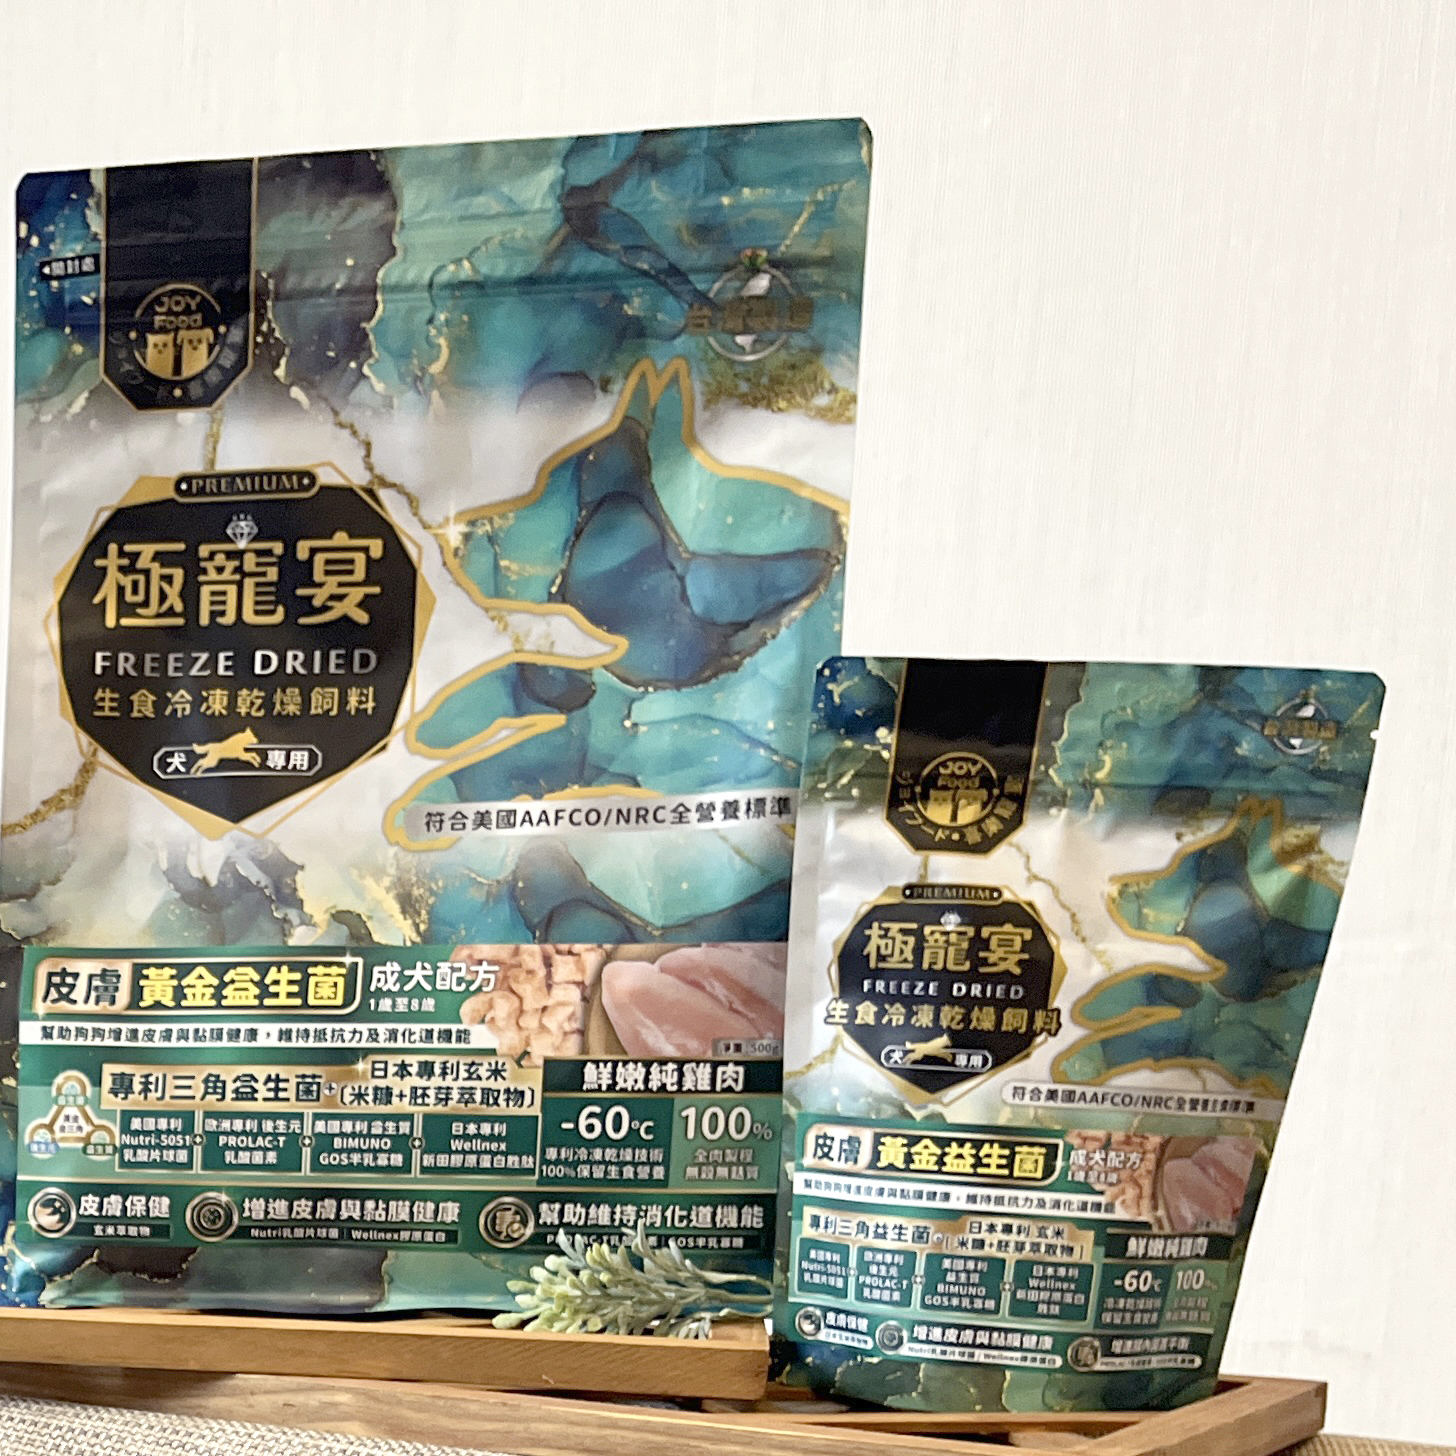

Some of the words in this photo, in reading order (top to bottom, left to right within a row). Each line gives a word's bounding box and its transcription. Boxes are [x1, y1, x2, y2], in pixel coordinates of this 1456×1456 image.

[155, 295, 201, 313] JOY
[154, 313, 202, 329] Food
[191, 474, 300, 495] PREMIUM
[92, 530, 384, 629] 極寵宴
[94, 651, 235, 677] FREEZE
[254, 649, 377, 676] DRIED
[93, 686, 376, 718] 生食冷凍乾燥飼料
[166, 752, 188, 773] 犬
[266, 749, 309, 770] 專用
[939, 762, 982, 776] JOY
[913, 886, 992, 900] PREMIUM
[863, 921, 1033, 976] 極寵宴
[42, 967, 121, 1006] 皮膚
[139, 965, 346, 1007] 黃金益生菌
[369, 961, 501, 992] 成犬配方
[863, 979, 939, 997] FREEZE
[953, 982, 1024, 999] DRIED
[826, 999, 1061, 1035] 生食冷凍乾燥飼料
[371, 1060, 507, 1081] 日本專利玄米
[582, 1061, 744, 1092] 鮮嫩純雞肉
[108, 1072, 322, 1102] 專利三角益生菌
[680, 1106, 773, 1141] 100%
[218, 1136, 286, 1148] PROLAC-T
[333, 1137, 391, 1150] BIMUNO
[451, 1139, 507, 1151] Wellnex
[813, 1132, 861, 1165] 皮膚
[876, 1136, 1046, 1179] 黃金益生菌
[78, 1193, 170, 1218] 皮膚保健
[243, 1197, 460, 1223] 增進皮膚與黏膜健康
[937, 1283, 986, 1296] BIMUNO
[1029, 1278, 1076, 1290] Wellnex
